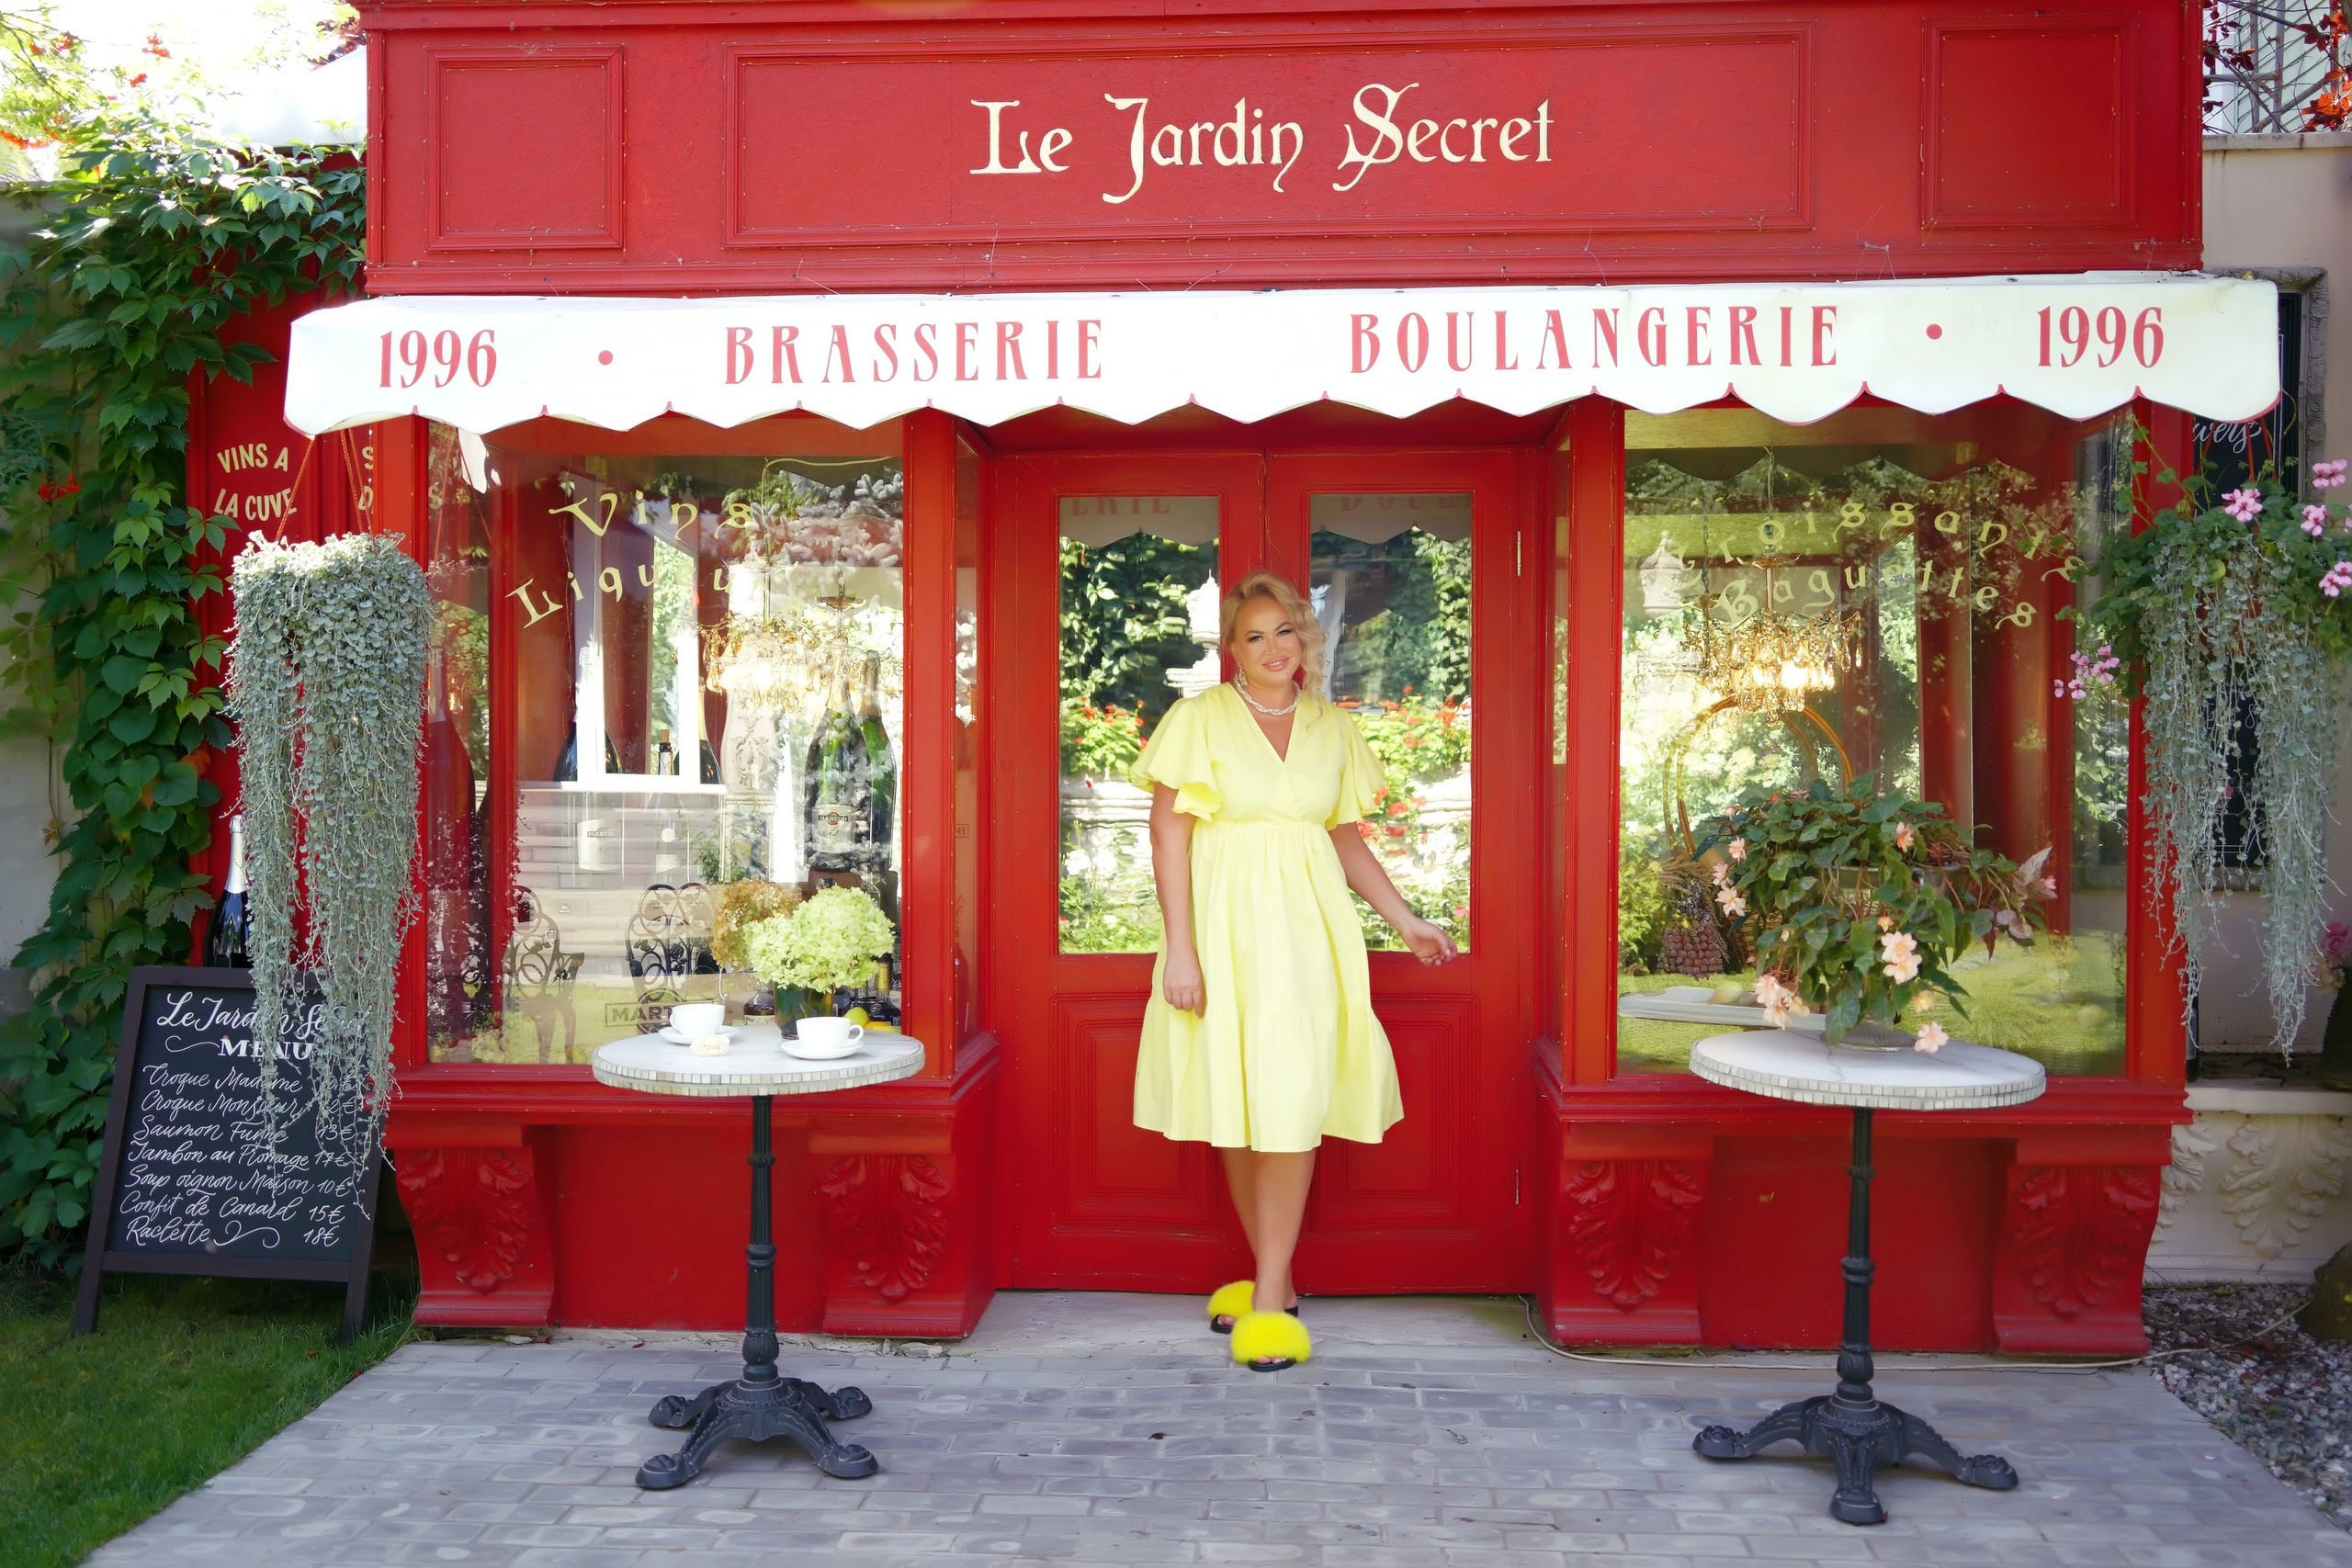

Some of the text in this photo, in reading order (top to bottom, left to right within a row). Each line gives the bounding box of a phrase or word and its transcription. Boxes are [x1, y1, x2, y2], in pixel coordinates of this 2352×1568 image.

[970, 82, 1554, 204] Le Jardin Secret
[379, 305, 2165, 389] 1996 BRASSERIE BOULANGERIE 1996
[217, 443, 288, 474] VINS A
[213, 487, 297, 521] LA CUVE
[548, 489, 752, 540] Vins
[1716, 558, 2038, 630] Baguettes
[157, 991, 197, 1027] Le
[142, 1063, 210, 1099] Croque
[141, 1089, 205, 1122] Croque
[133, 1114, 224, 1141] Saumon
[127, 1140, 208, 1165] Jambon
[209, 1148, 233, 1163] au
[124, 1164, 352, 1197] Soup oignon Maison 10€
[119, 1190, 345, 1224] Confit de Canard 15€
[126, 1215, 340, 1247] Raclette 18€
